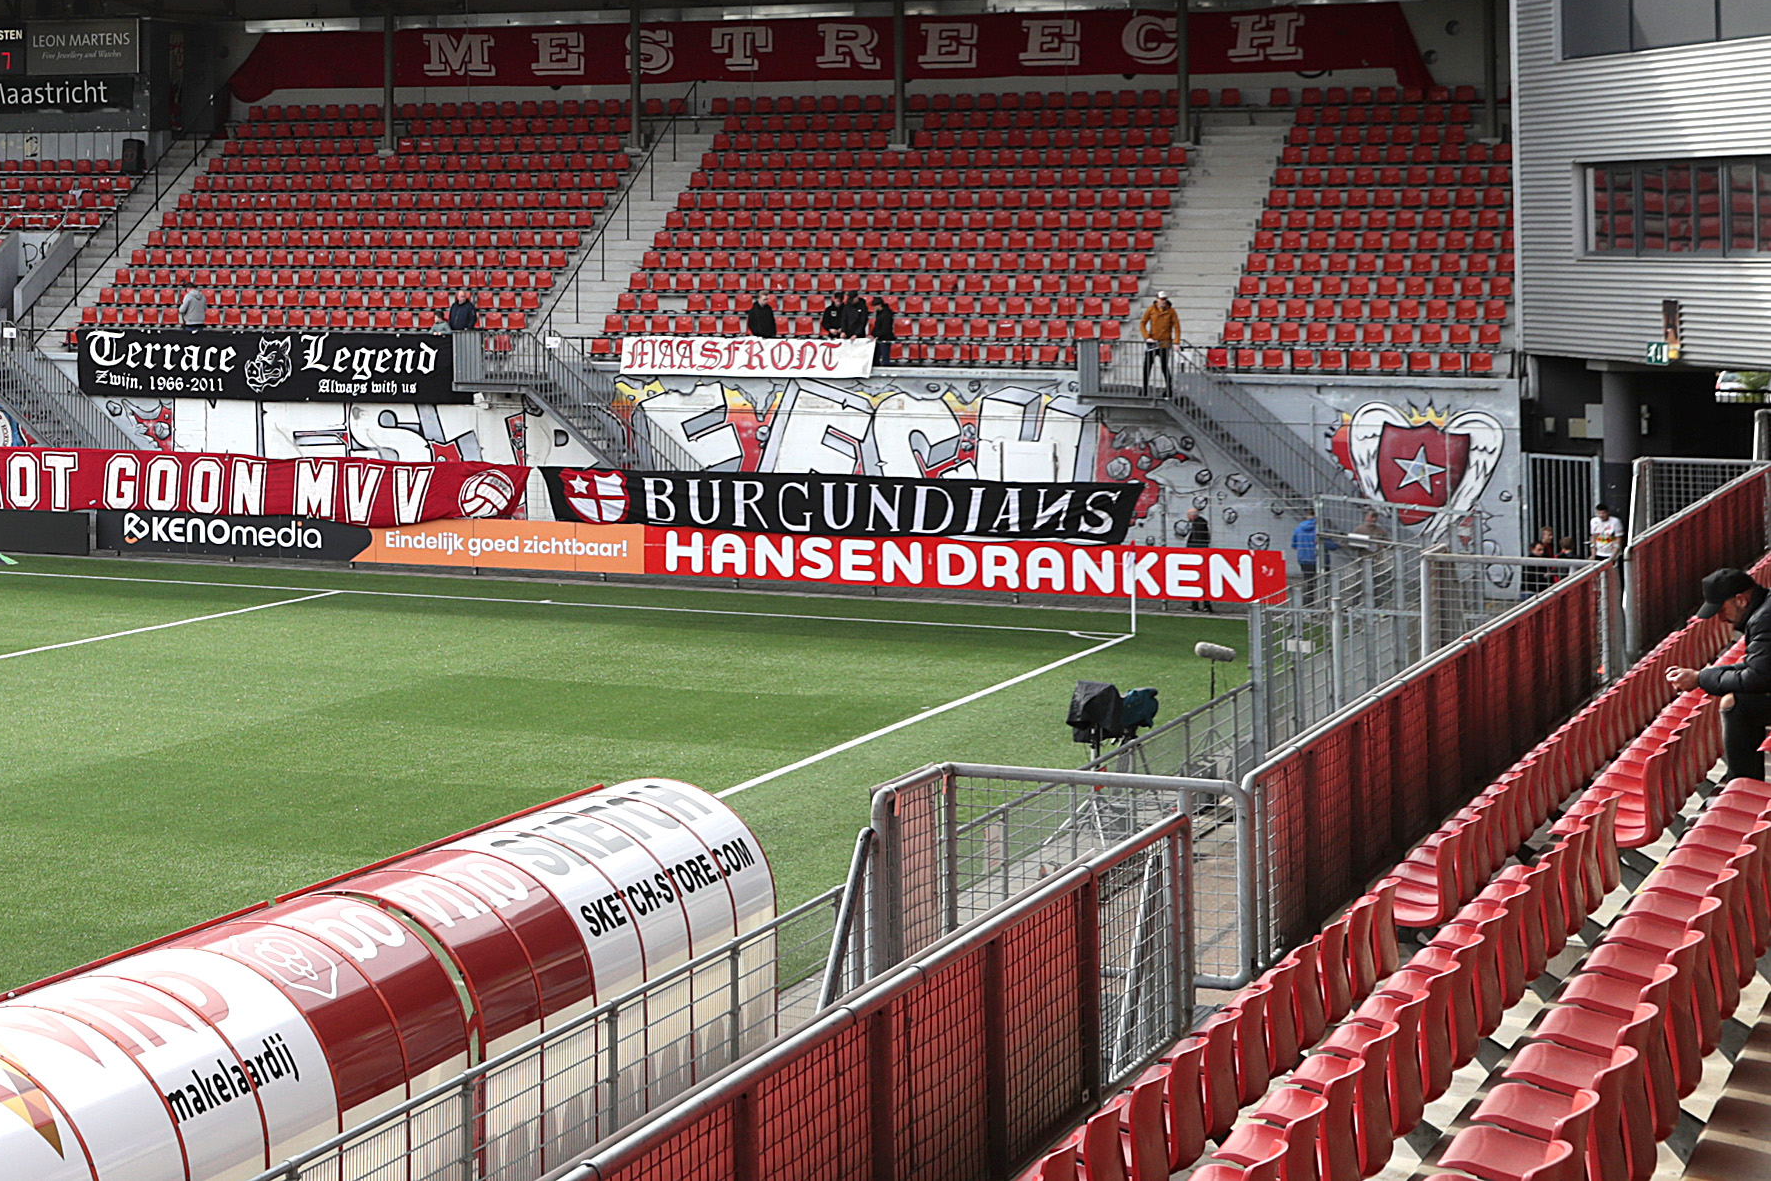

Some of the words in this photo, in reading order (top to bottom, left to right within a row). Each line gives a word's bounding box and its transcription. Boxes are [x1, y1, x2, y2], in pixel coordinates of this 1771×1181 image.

[32, 34, 66, 48] LEON
[69, 32, 131, 46] MARTENS
[41, 51, 56, 60] Fine
[85, 50, 97, 58] and
[1, 51, 12, 70] 7
[86, 330, 237, 372] Terrace
[300, 331, 439, 380] Legend
[624, 338, 843, 371] MAASFRONT
[94, 370, 144, 391] Zwijn,
[149, 375, 224, 393] 1966-2011
[317, 379, 368, 396] Always
[371, 379, 398, 396] with
[400, 383, 417, 395] us
[102, 452, 267, 516] GOON
[293, 457, 436, 526] MVV
[641, 476, 1123, 535] BURGUNDIANS
[152, 516, 323, 550] KENOmedia
[385, 530, 464, 556] Eindelijk
[467, 535, 520, 557] goed
[523, 535, 629, 558] zichtbaar!
[665, 529, 923, 585] HANSEN
[936, 542, 1255, 600] DRANKEN
[491, 785, 716, 876] SKETCH
[580, 837, 757, 938] SKETCH-STORE.COM
[164, 1032, 301, 1125] makelaardij
